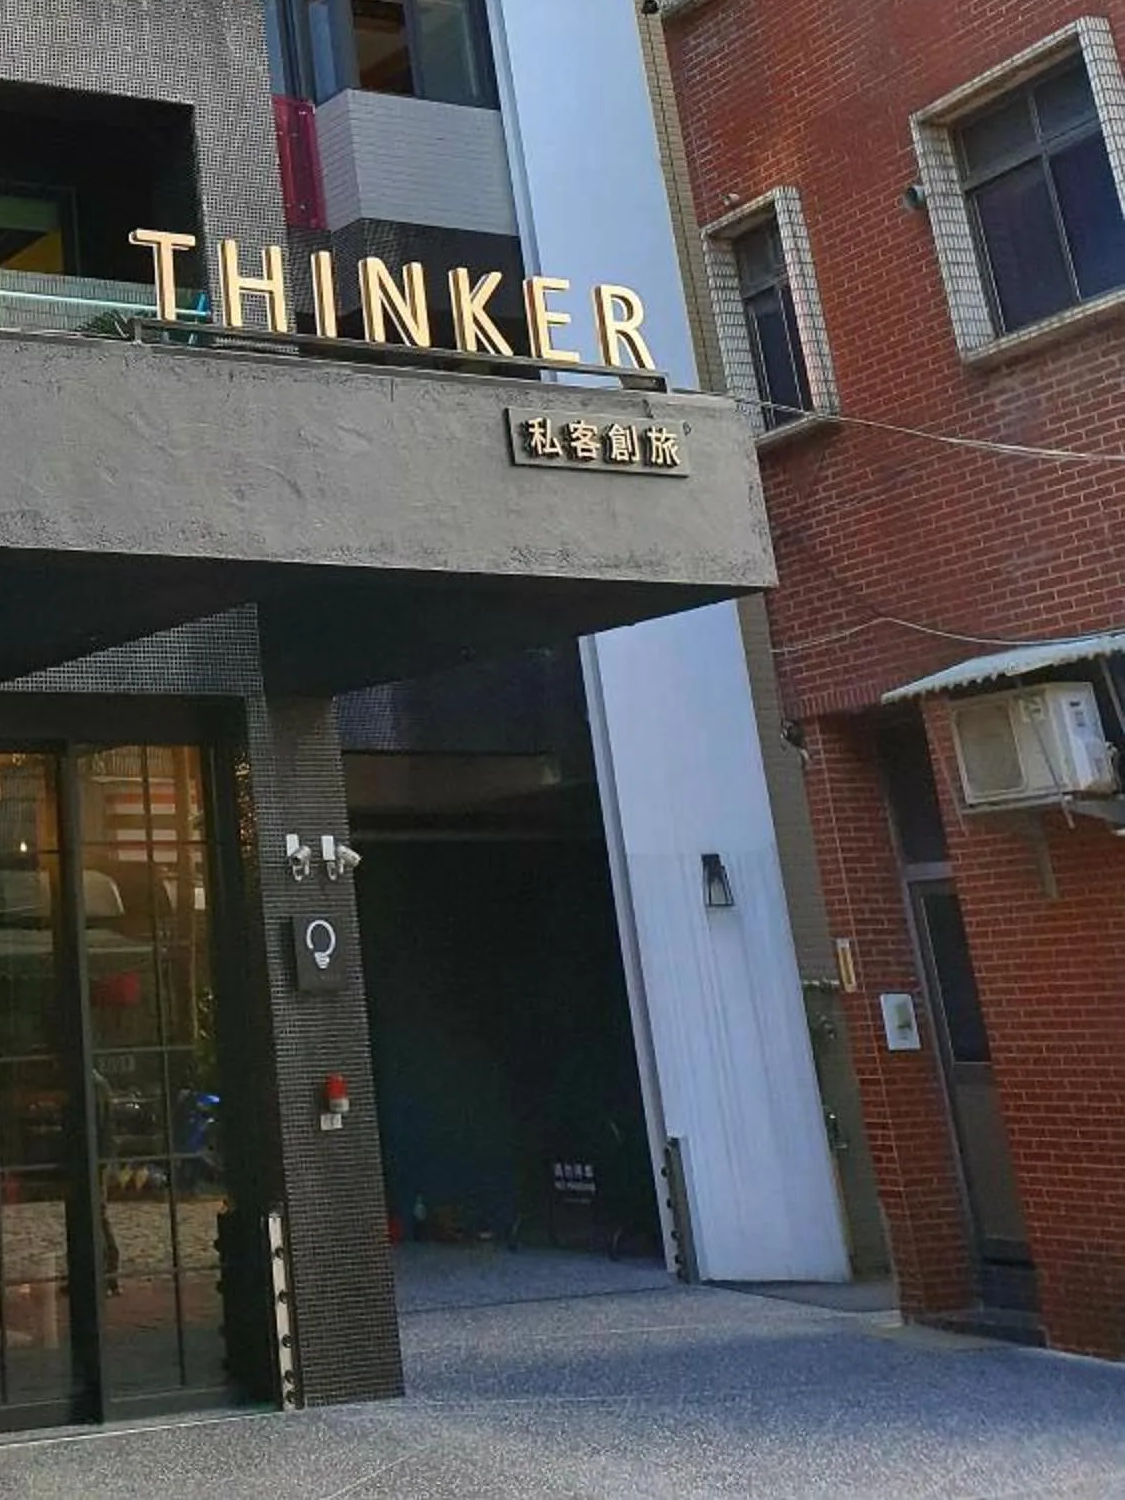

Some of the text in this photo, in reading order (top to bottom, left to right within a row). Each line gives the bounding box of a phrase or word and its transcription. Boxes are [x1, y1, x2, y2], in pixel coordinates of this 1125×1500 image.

[129, 228, 656, 371] THINKER
[523, 417, 682, 467] 私客創旅
